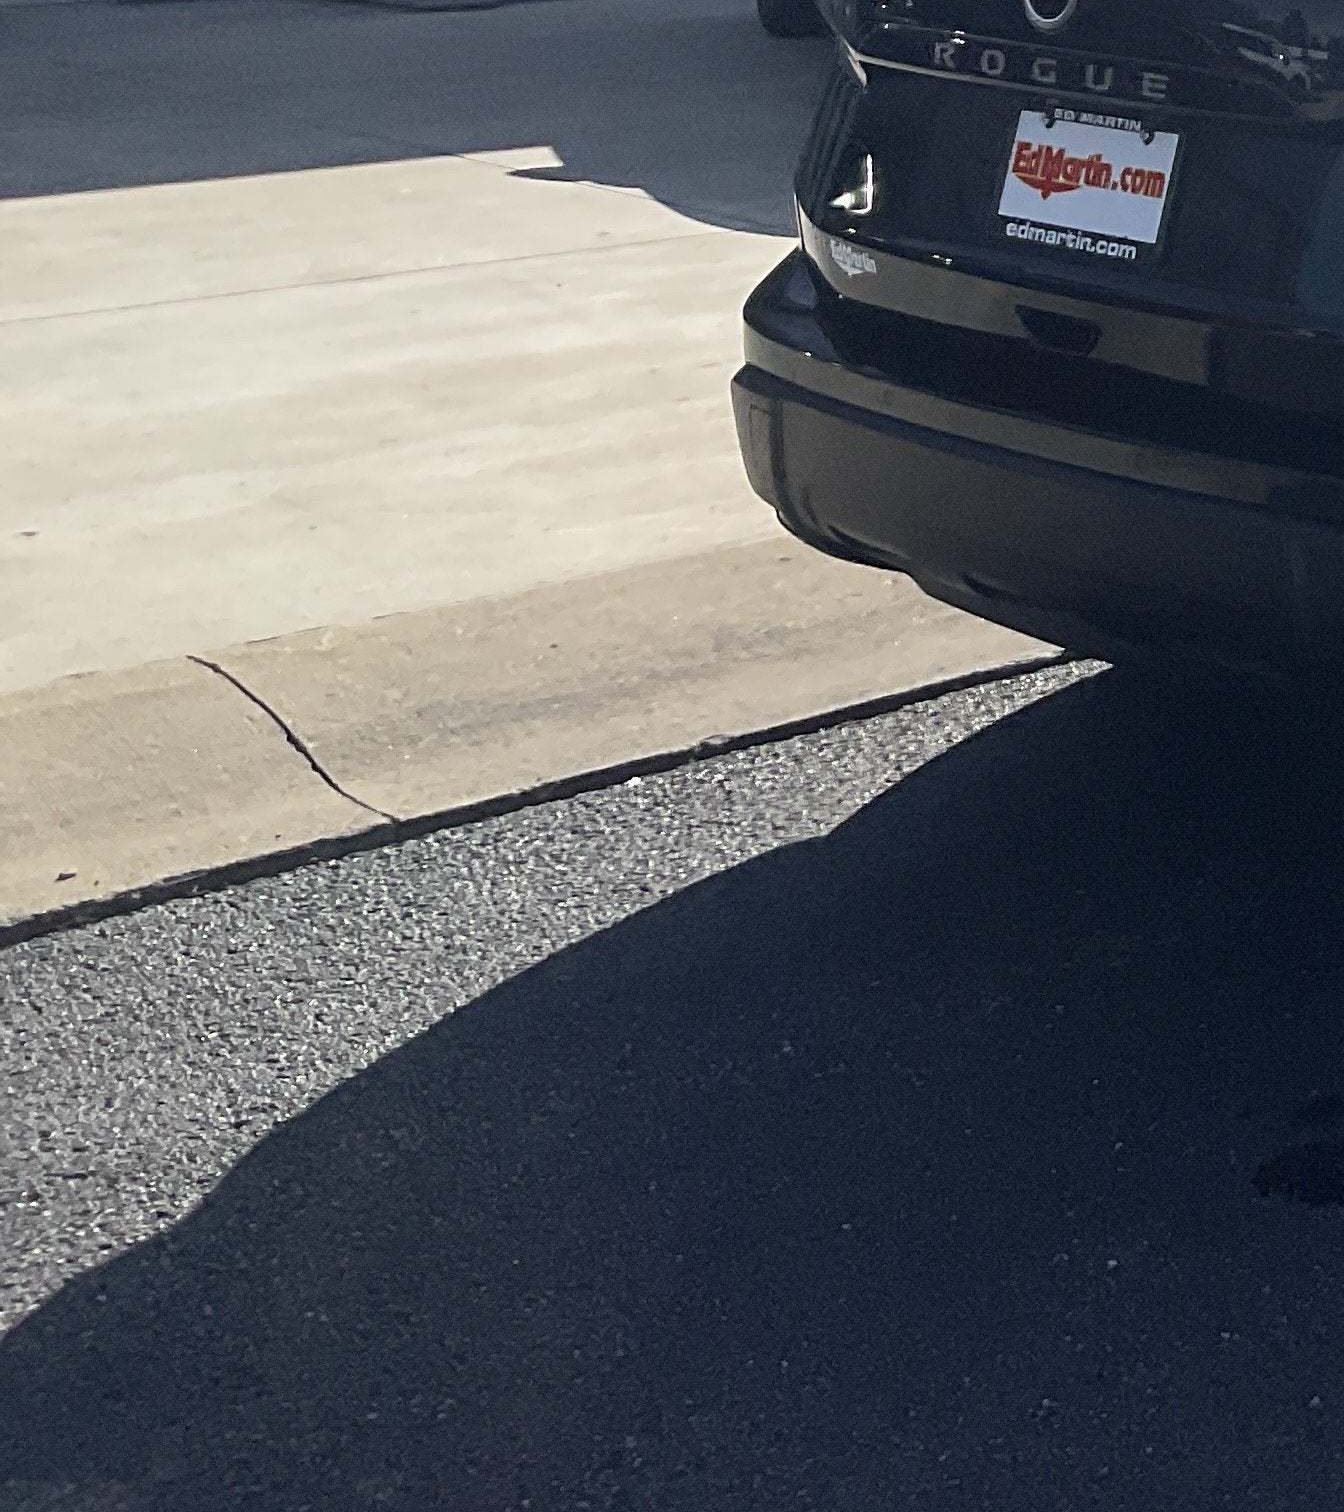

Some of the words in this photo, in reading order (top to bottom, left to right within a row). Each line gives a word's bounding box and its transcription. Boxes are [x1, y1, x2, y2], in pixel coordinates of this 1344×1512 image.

[934, 42, 1170, 99] ROGUE
[1054, 108, 1076, 121] ED
[1080, 112, 1142, 131] MARTIN
[1006, 221, 1138, 260] edmartin.com
